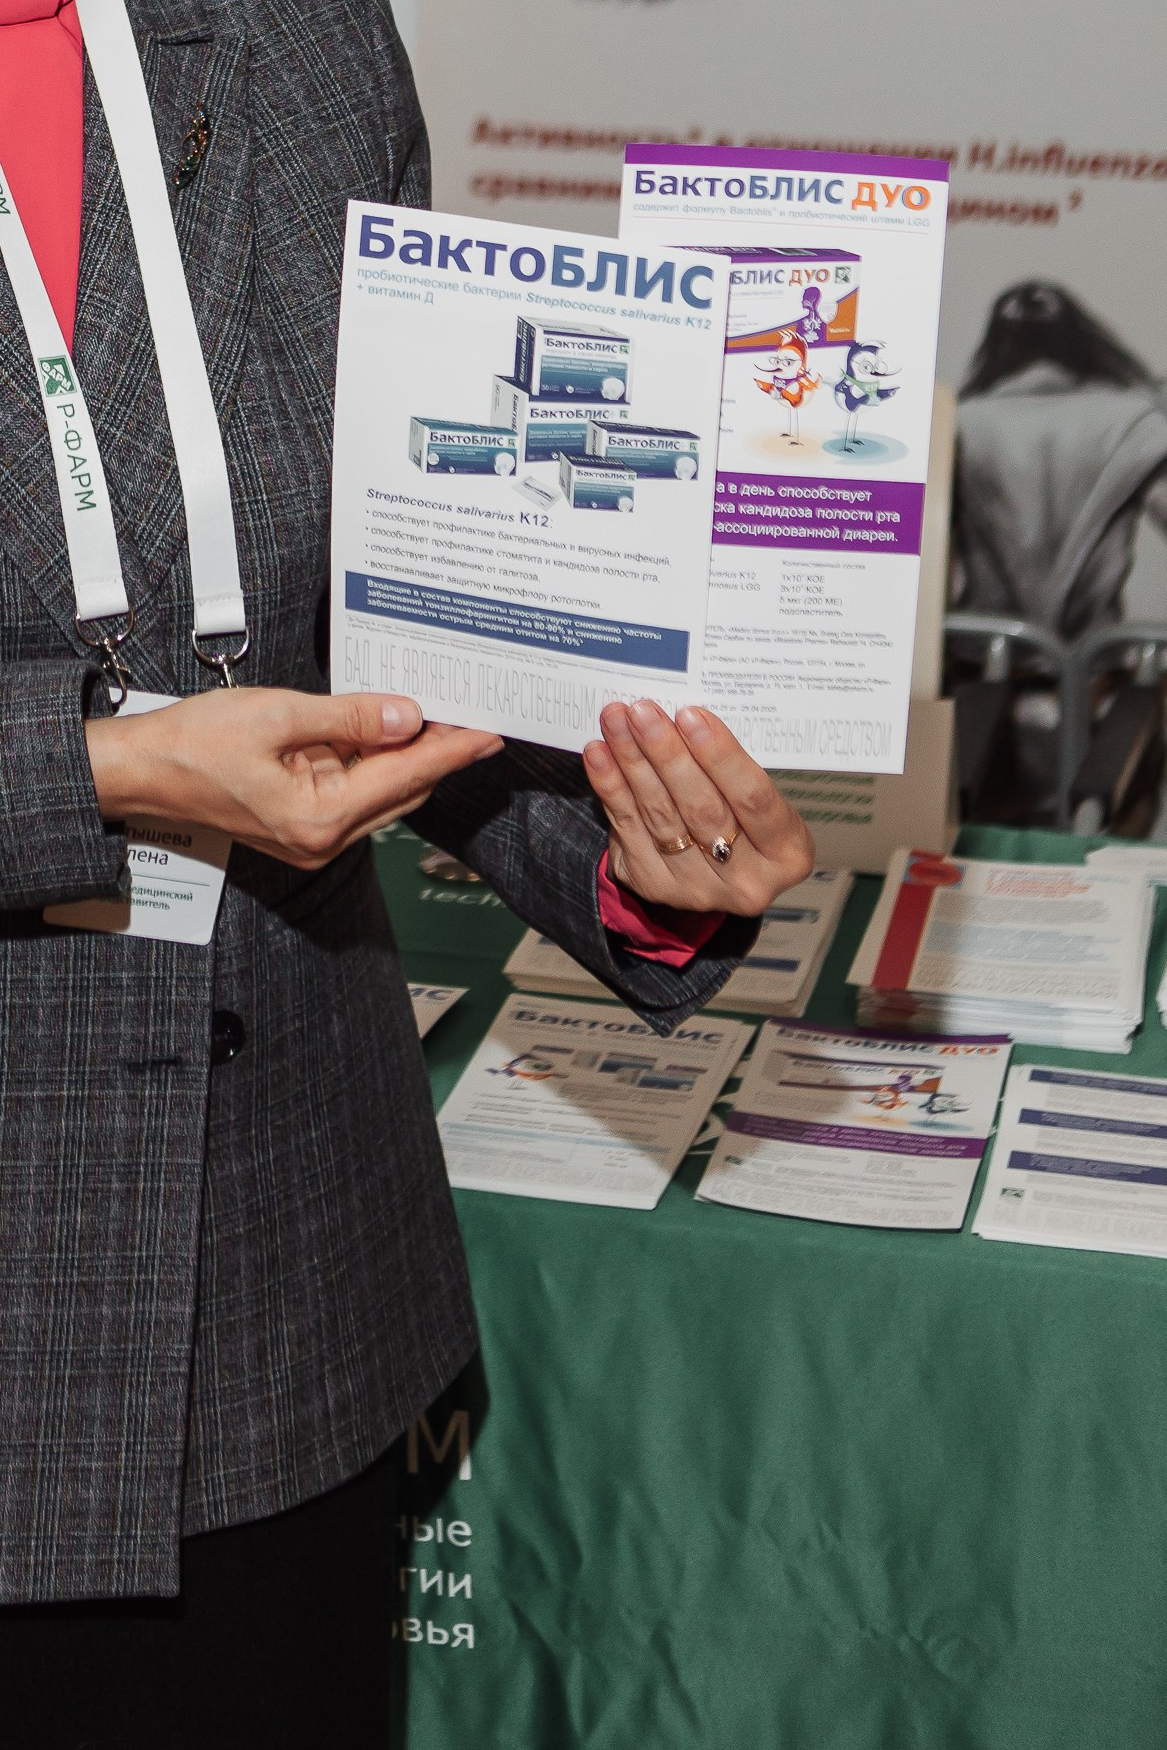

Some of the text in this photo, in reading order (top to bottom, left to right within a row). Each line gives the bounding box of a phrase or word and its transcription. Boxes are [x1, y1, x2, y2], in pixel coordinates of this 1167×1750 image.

[635, 170, 931, 212] БактоБЛИС ДУО
[633, 204, 679, 214] содержит
[683, 205, 726, 217] формулу
[789, 210, 868, 225] пробиотический
[871, 216, 905, 226] штамм
[358, 214, 715, 310] БактоБЛИС
[789, 269, 831, 286] ДУО
[358, 268, 712, 331] пробиотические бактерии Streptococcus salivarius K12
[368, 285, 434, 306] витамин Д
[545, 338, 618, 354] БактоБЛИС
[530, 408, 610, 420] БактоБЛИС
[57, 403, 97, 512] Р-ФАРМ
[430, 431, 504, 448] БактоБЛИС
[608, 436, 680, 451] БактоБЛИС
[367, 488, 452, 513] Streptococcus
[456, 506, 515, 524] salivarius
[728, 482, 737, 493] в
[740, 483, 775, 497] день
[777, 486, 872, 503] способствует
[738, 503, 812, 519] кандидоза
[816, 507, 873, 521] полости
[875, 510, 900, 524] рта
[372, 509, 430, 528] способствует
[433, 521, 496, 540] профилактике
[498, 531, 567, 551] бактериальных
[578, 545, 621, 559] вирусных
[370, 543, 428, 562] способствует
[431, 556, 485, 573] избавлению
[486, 566, 497, 575] от
[371, 526, 428, 544] способствует
[431, 538, 494, 557] профилактике
[497, 550, 543, 566] стоматита
[553, 560, 600, 575] кандидоза
[603, 567, 640, 580] полости
[370, 561, 444, 582] восстанавливает
[447, 575, 490, 591] защитную
[493, 585, 548, 602] микрофлору
[367, 579, 411, 595] Входящие
[421, 591, 450, 603] состав
[453, 597, 507, 614] компоненты
[509, 608, 572, 626] способствуют
[575, 620, 621, 635] снижению
[623, 628, 662, 641] частоты
[367, 589, 423, 607] заболеваний
[425, 600, 519, 626] тонзиллофарингитом
[521, 619, 532, 629] на
[574, 630, 622, 645] снижению
[367, 599, 437, 619] заболеваемости
[439, 613, 473, 627] острым
[475, 620, 513, 634] средним
[515, 628, 547, 641] отитом
[549, 634, 560, 643] на
[381, 644, 397, 690] НЕ
[403, 648, 470, 706] ЯВЛЯЕТСЯ
[476, 663, 598, 733] ЛЕКАРСТВЕННЫМ
[392, 1618, 475, 1649] вья
